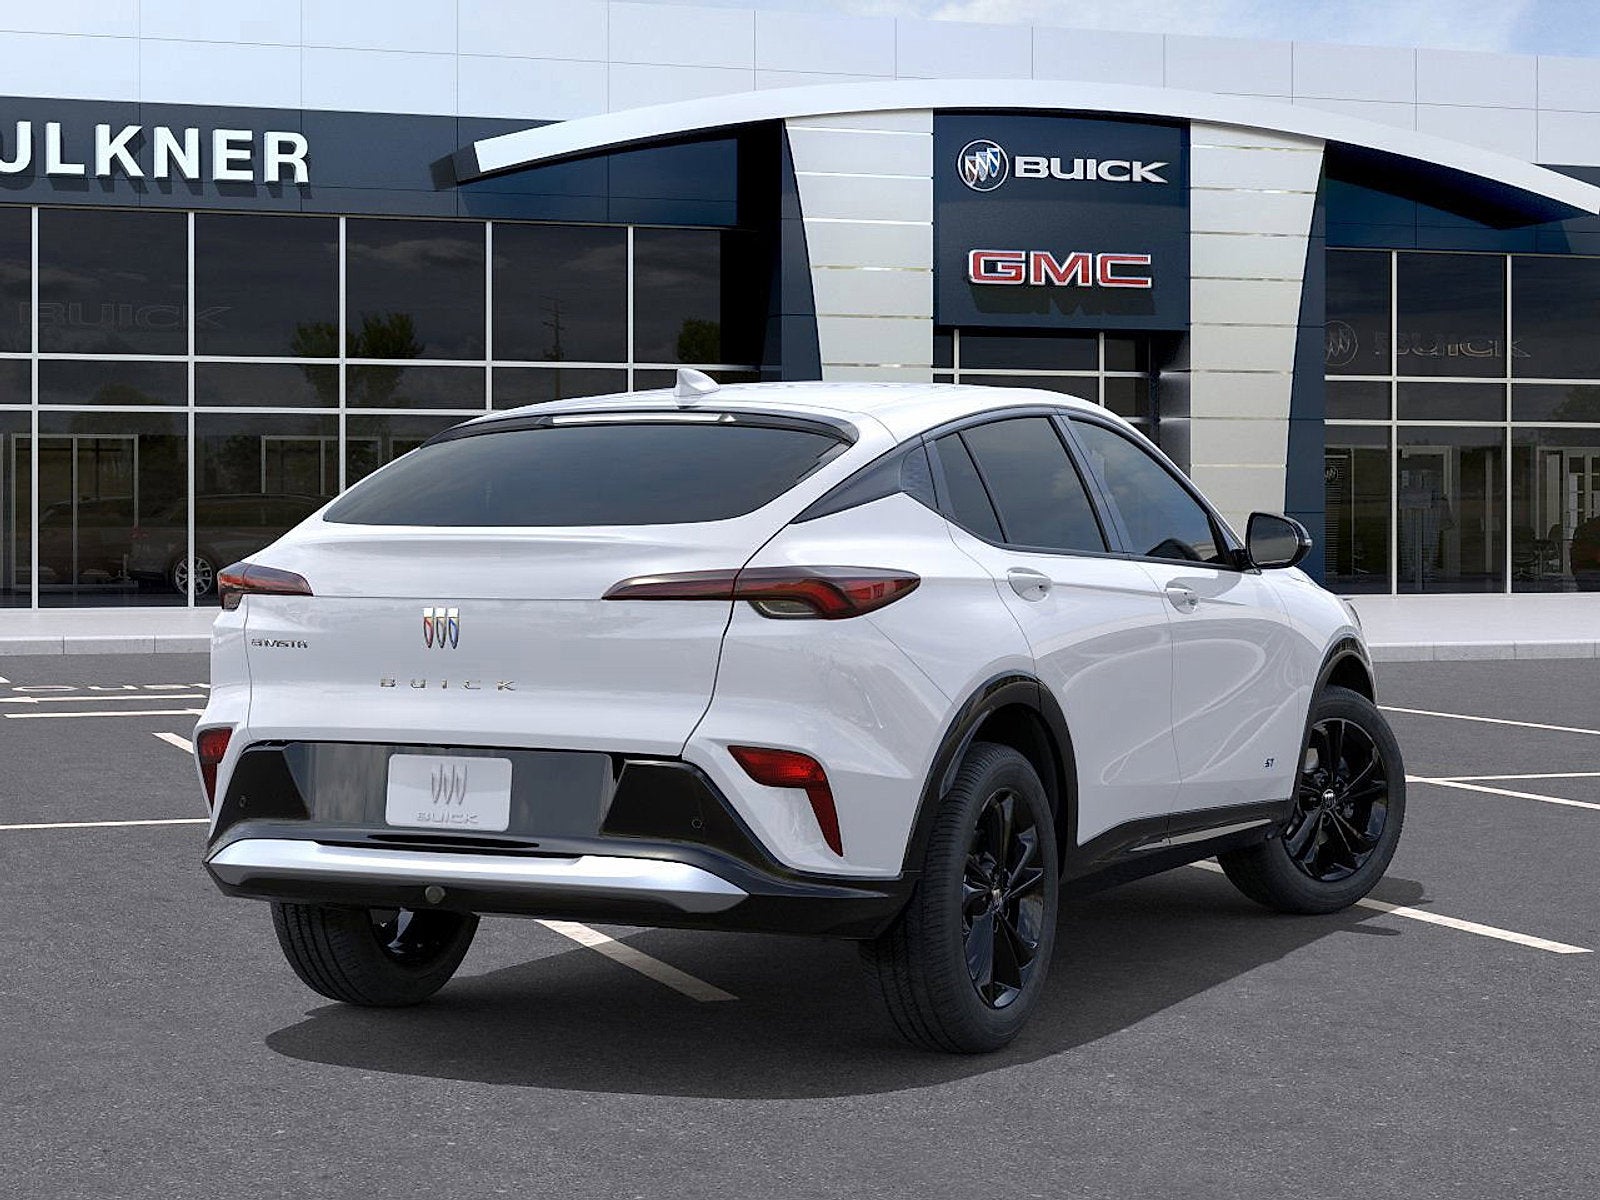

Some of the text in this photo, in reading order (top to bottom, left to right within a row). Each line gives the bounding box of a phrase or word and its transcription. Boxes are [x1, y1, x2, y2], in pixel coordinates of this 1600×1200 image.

[1014, 155, 1170, 184] BUICK
[968, 249, 1153, 289] GMC
[380, 678, 517, 692] BUICK
[416, 811, 480, 824] BUICK
